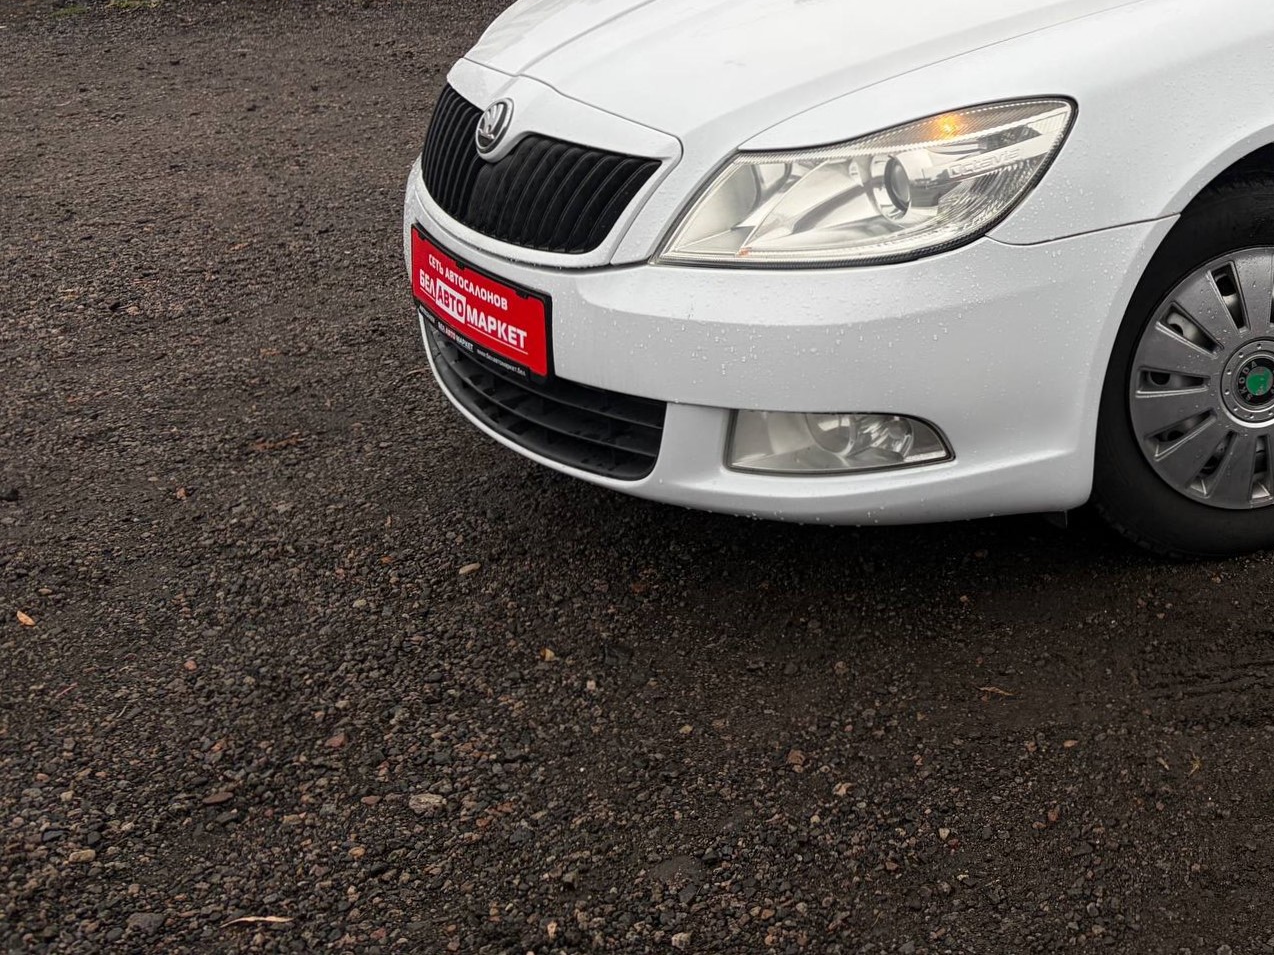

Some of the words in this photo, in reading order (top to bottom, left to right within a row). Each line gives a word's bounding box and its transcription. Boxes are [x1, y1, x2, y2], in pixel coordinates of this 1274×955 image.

[420, 269, 436, 298] БЕЛ
[437, 281, 465, 318] АВТО
[466, 304, 527, 349] МАРКЕТ
[428, 254, 444, 275] СЕТЬ
[445, 268, 508, 311] АВТОСАЛОНОВ
